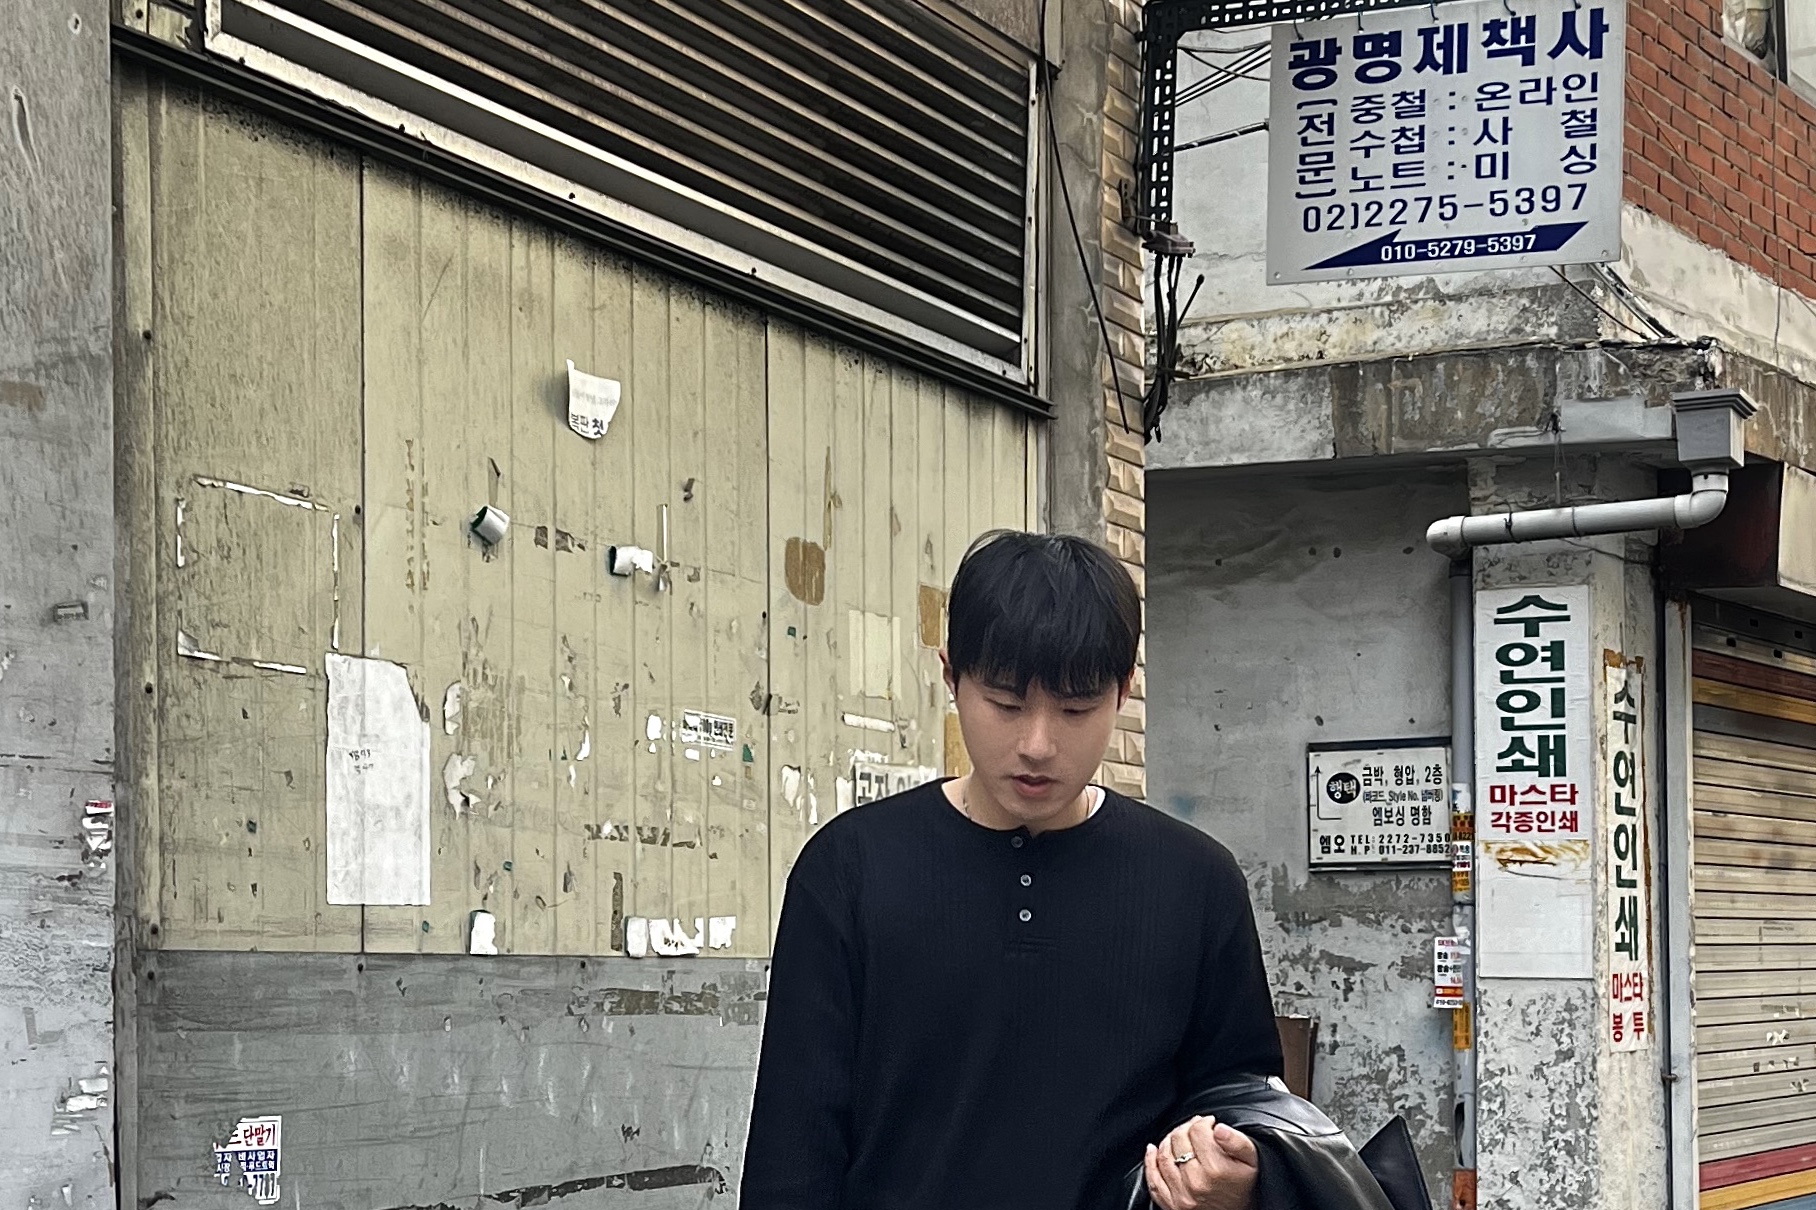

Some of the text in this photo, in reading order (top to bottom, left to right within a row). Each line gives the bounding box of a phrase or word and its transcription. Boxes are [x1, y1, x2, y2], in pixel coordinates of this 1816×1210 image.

[1288, 8, 1609, 91] 광명제책사
[1350, 89, 1426, 124] 중철
[1475, 72, 1598, 112] 온라인
[1349, 124, 1426, 159] 수첩
[1348, 160, 1426, 194] 노트
[1302, 183, 1589, 233] 02)2275-5397
[1380, 233, 1537, 262] 010-5279-5397
[1493, 593, 1572, 779] 수연인쇄
[1424, 763, 1443, 785] 2층
[1489, 783, 1579, 806] 마스타
[1372, 804, 1432, 827] 엠보싱 명함
[1490, 810, 1579, 834] 각종인쇄
[1612, 678, 1640, 962] 수연인쇄
[1378, 832, 1451, 844] 2272-7350
[1611, 971, 1645, 1004] 마스타
